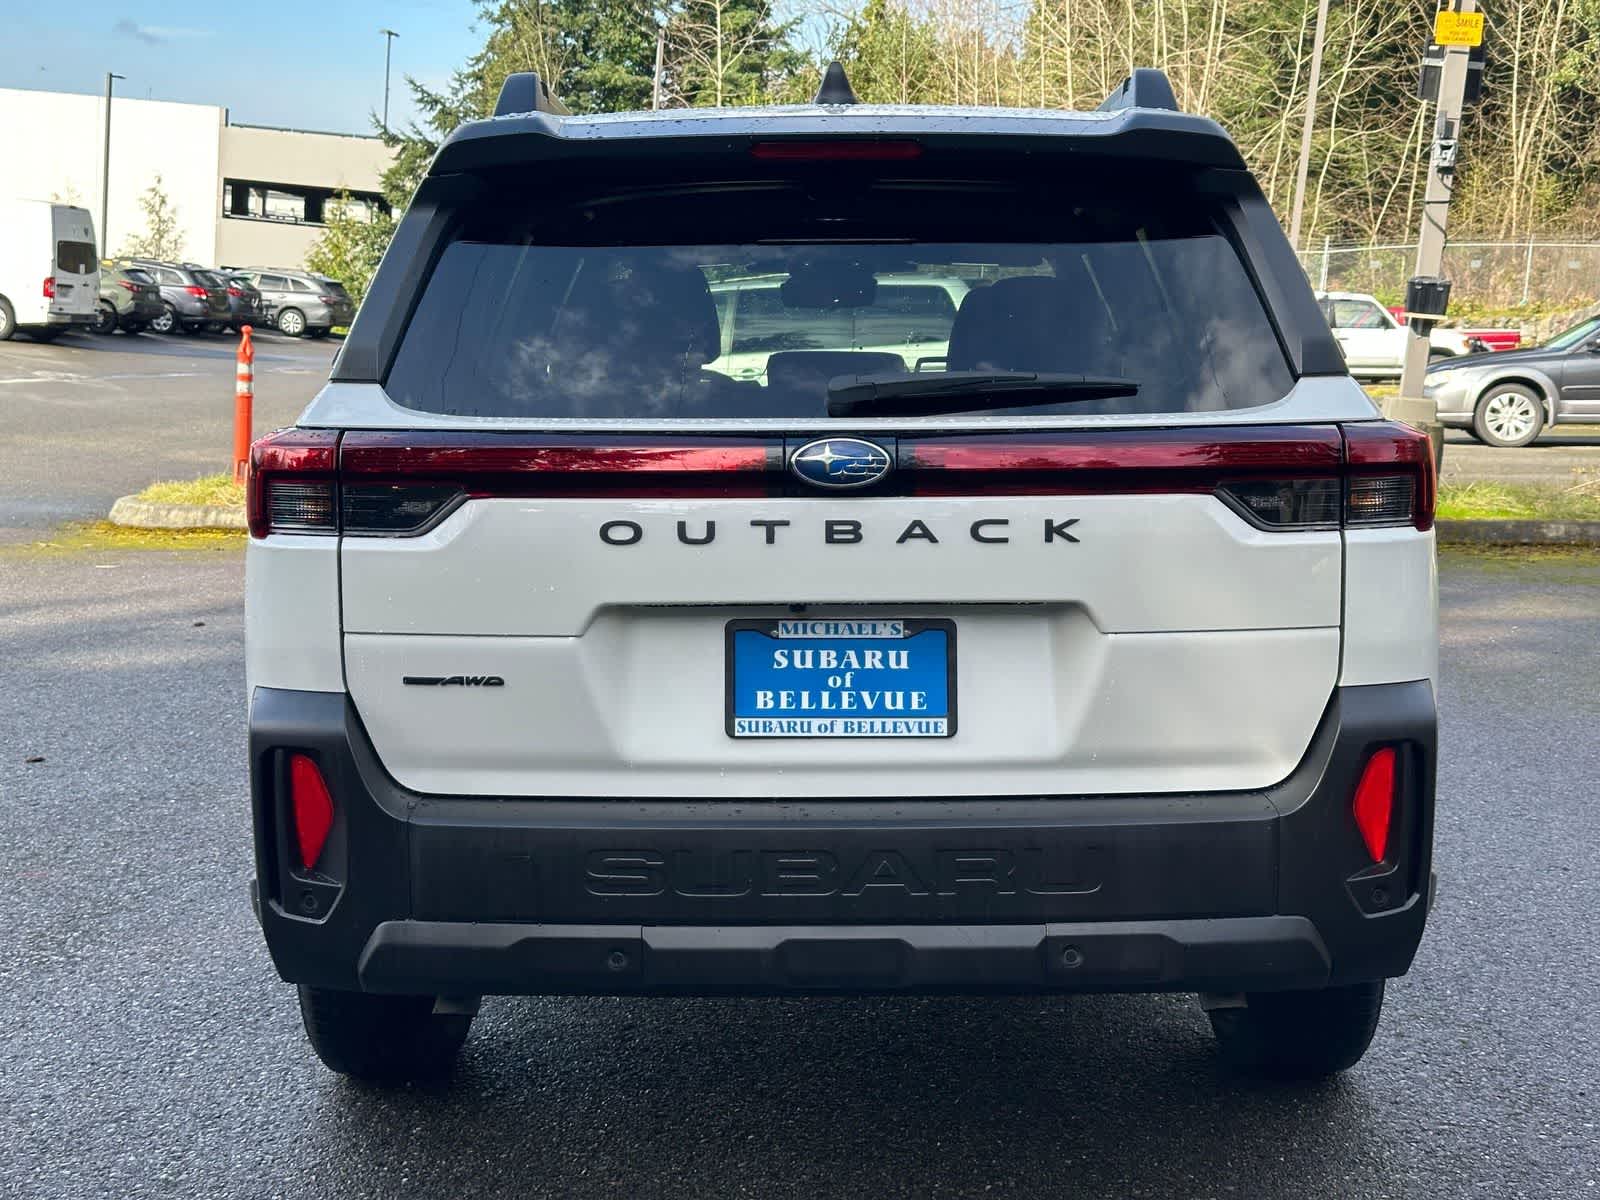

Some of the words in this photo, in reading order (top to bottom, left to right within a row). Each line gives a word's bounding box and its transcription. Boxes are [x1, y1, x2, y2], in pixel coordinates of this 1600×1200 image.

[1455, 18, 1480, 28] SMILE
[599, 518, 1081, 545] OUTBACK
[780, 622, 902, 636] MICHAEL'S
[773, 649, 910, 669] SUBARU
[440, 676, 505, 687] AWD
[827, 671, 854, 688] of
[755, 690, 927, 710] BELLEVUE
[736, 719, 812, 734] SUBARU
[817, 719, 838, 734] of
[843, 719, 944, 734] BELLEVUE
[585, 849, 1102, 897] SUBARU
